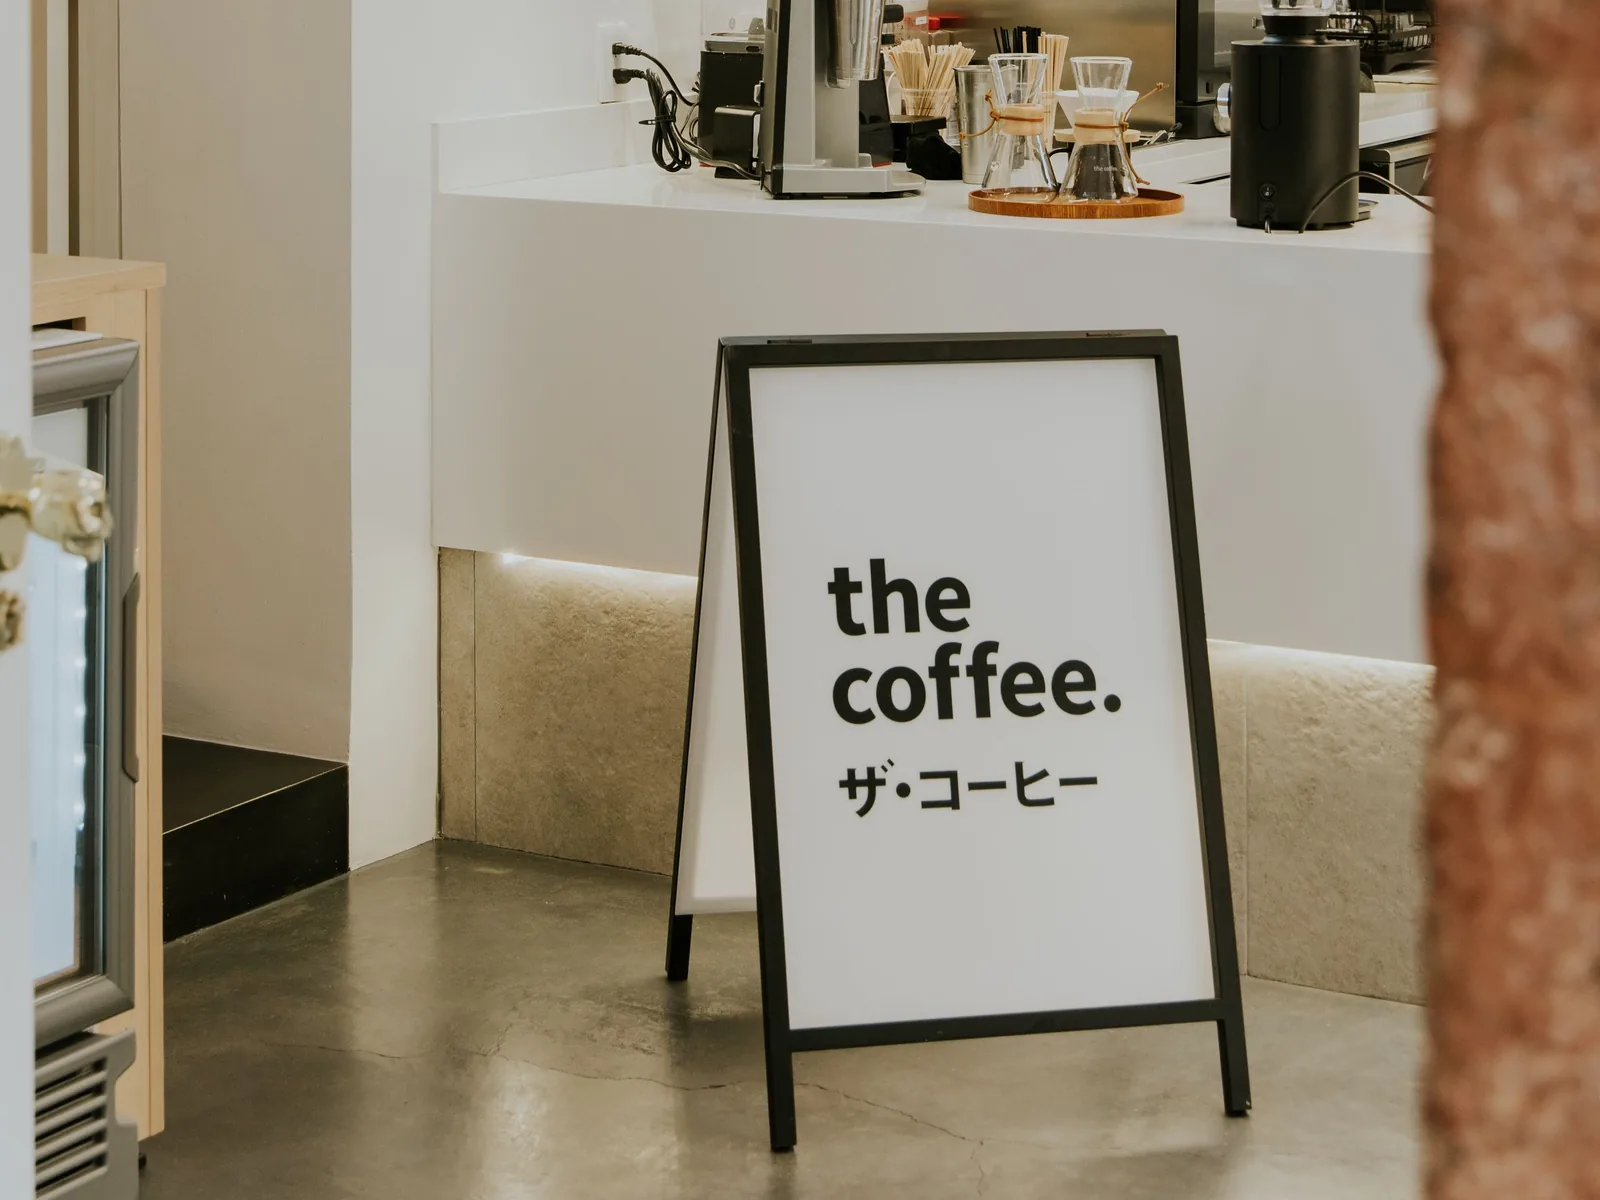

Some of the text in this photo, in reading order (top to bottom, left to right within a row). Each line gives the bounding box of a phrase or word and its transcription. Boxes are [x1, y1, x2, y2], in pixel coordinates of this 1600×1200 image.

[827, 558, 971, 637] the
[832, 640, 1122, 725] coffee.
[838, 758, 1098, 818] ザ・コーヒー
